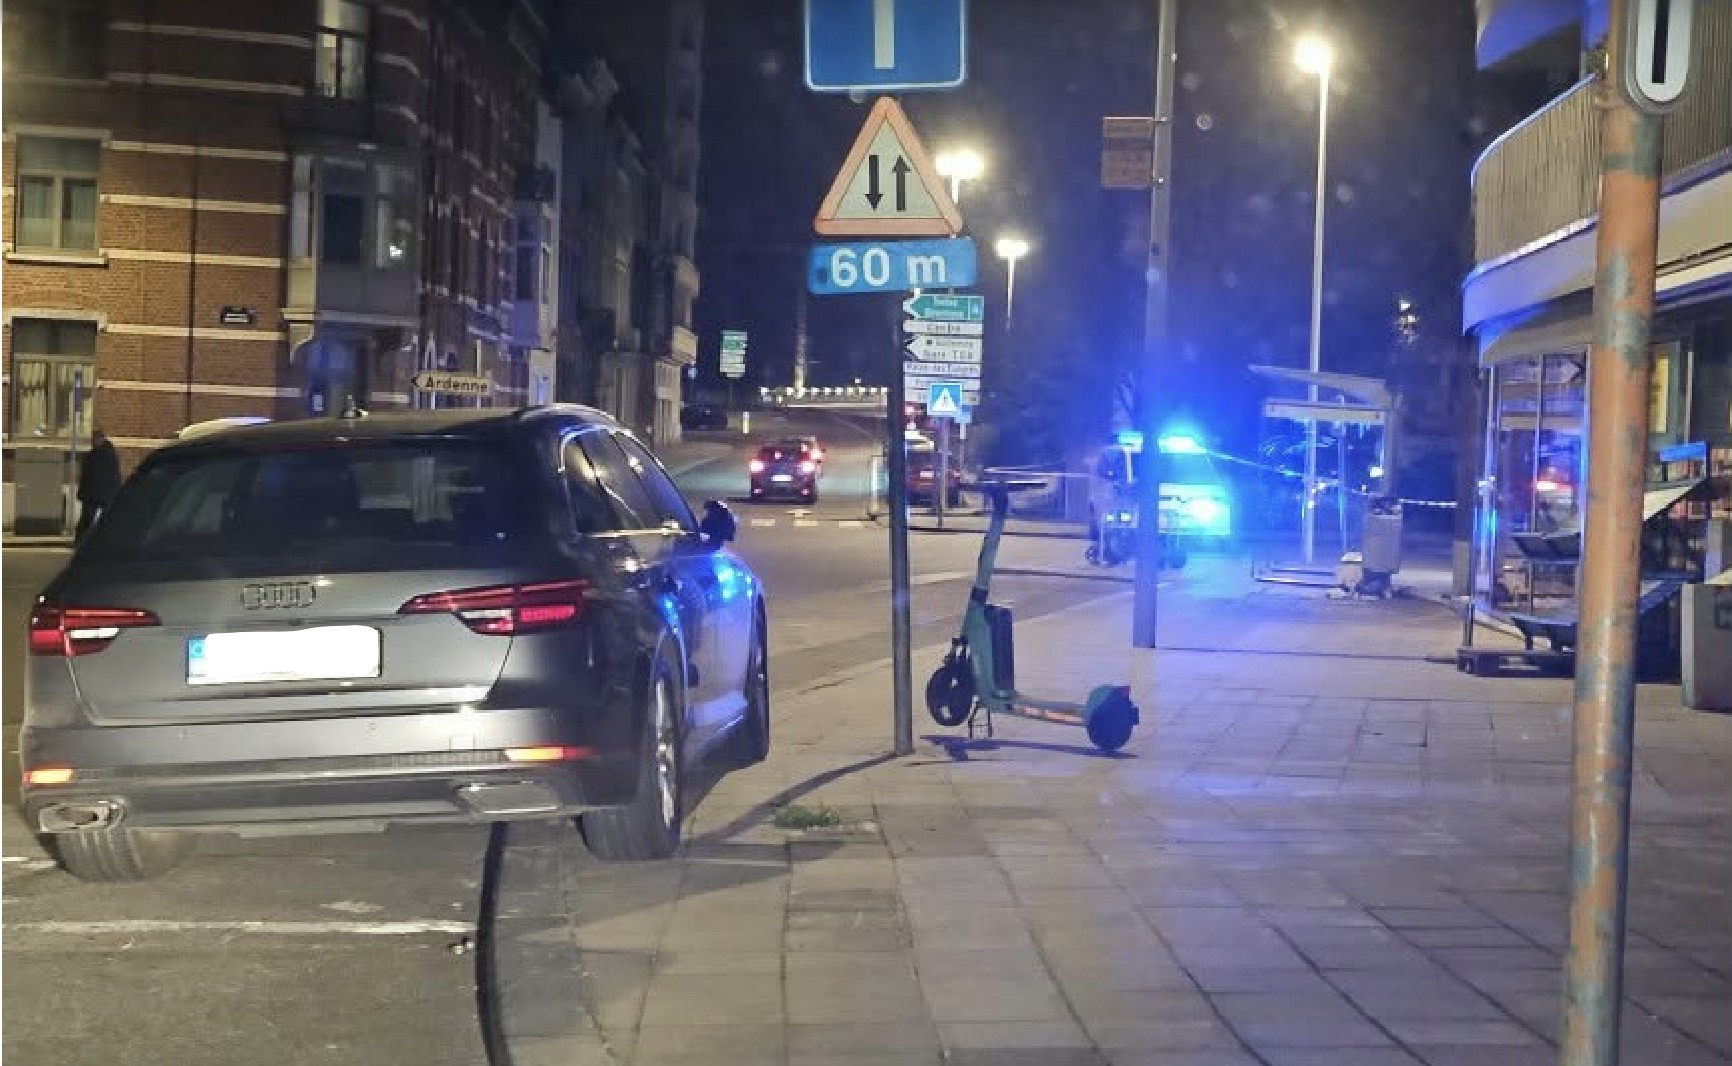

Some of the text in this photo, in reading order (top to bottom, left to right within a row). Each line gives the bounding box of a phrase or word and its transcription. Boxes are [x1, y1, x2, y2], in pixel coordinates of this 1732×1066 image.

[831, 247, 946, 287] 60 m
[425, 376, 488, 393] Ardenne
